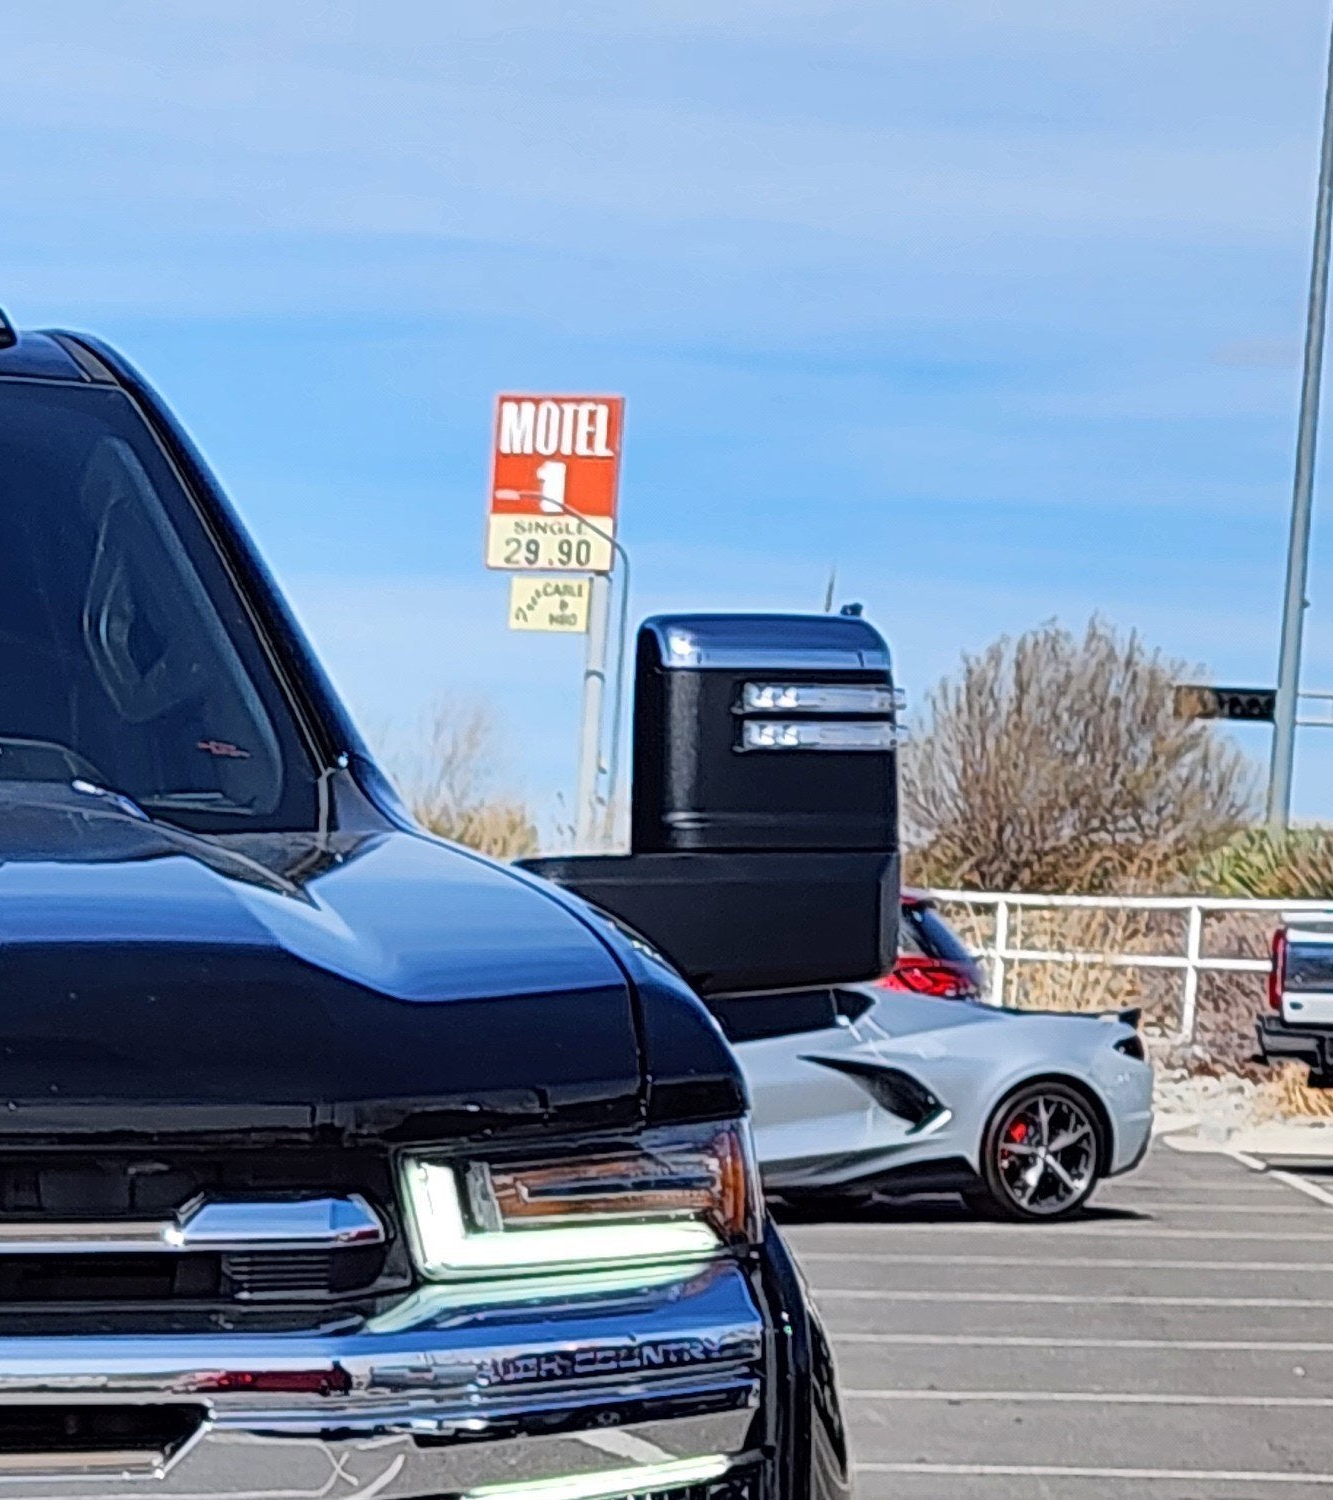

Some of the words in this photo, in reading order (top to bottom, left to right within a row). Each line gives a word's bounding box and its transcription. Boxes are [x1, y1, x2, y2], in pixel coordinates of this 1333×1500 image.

[499, 400, 615, 457] MOTEL
[536, 460, 567, 513] 1
[513, 519, 589, 536] SINGLE
[573, 1338, 723, 1373] COUNTRY
